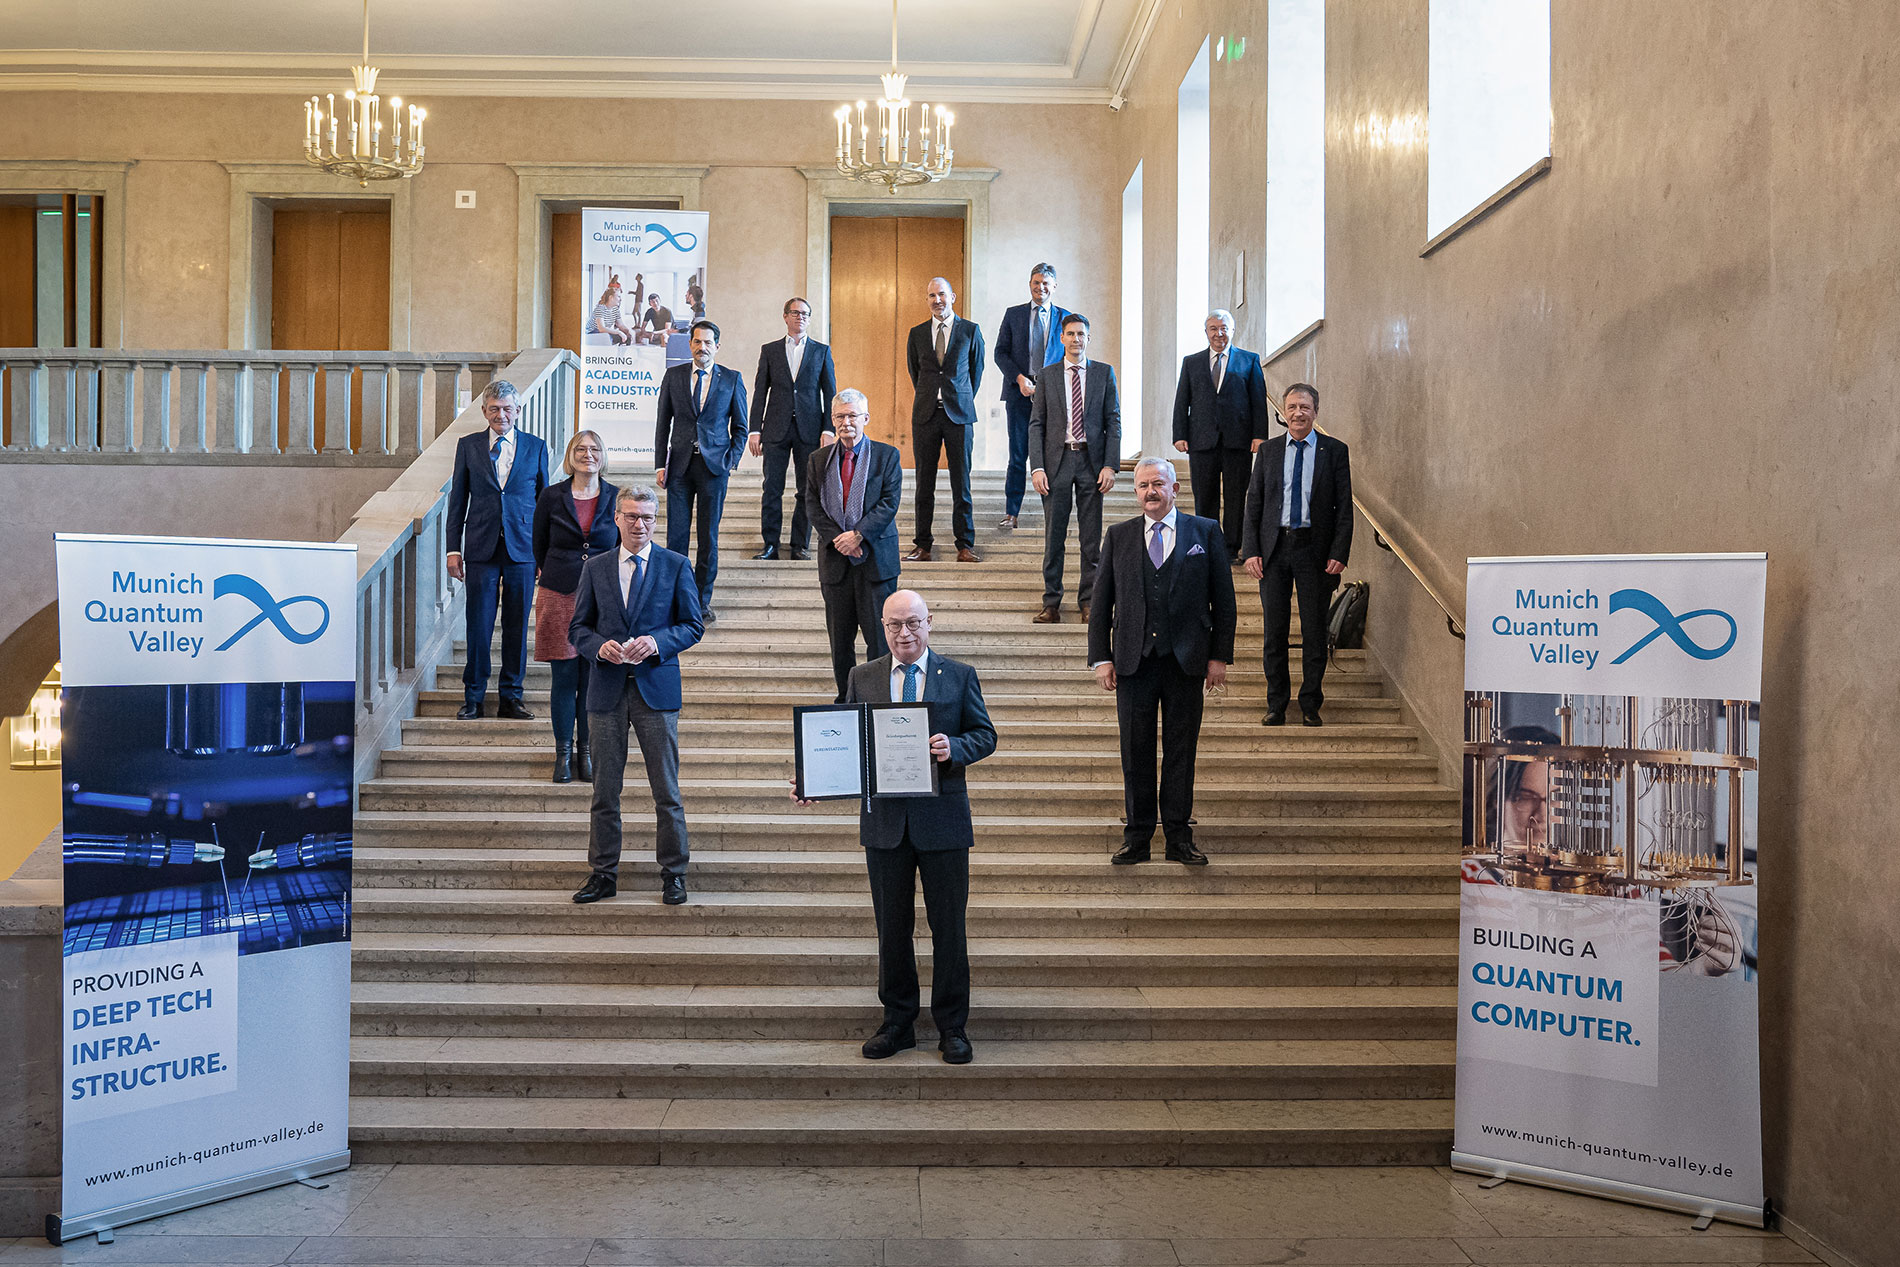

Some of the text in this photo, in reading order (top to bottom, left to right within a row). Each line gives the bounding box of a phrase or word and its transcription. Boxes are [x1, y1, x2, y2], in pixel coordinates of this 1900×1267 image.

[593, 232, 641, 242] Quantum
[604, 221, 641, 231] Munich
[611, 244, 641, 256] Valley
[585, 356, 633, 365] BRINGING
[585, 369, 653, 381] ACADEMIA
[585, 384, 660, 396] & INDUSTRY
[584, 401, 638, 411] TOGETHER.
[112, 571, 203, 594] Munich
[84, 600, 203, 623] Quantum
[1515, 589, 1599, 609] Munich
[1491, 615, 1599, 636] Quantum
[129, 630, 204, 658] Valley
[1529, 643, 1600, 670] Valley
[1473, 927, 1597, 959] BUILDING A
[73, 961, 204, 996] PROVIDING A
[1472, 962, 1622, 1003] QUANTUM
[72, 988, 212, 1031] DEEP TECH
[1471, 1001, 1641, 1046] COMPUTER.
[72, 1032, 161, 1066] INFRA-
[71, 1052, 227, 1101] STRUCTURE.
[85, 1120, 324, 1187] www.munich-quantum-valley.de
[1481, 1124, 1733, 1178] www.munich-quantum-valley.de
